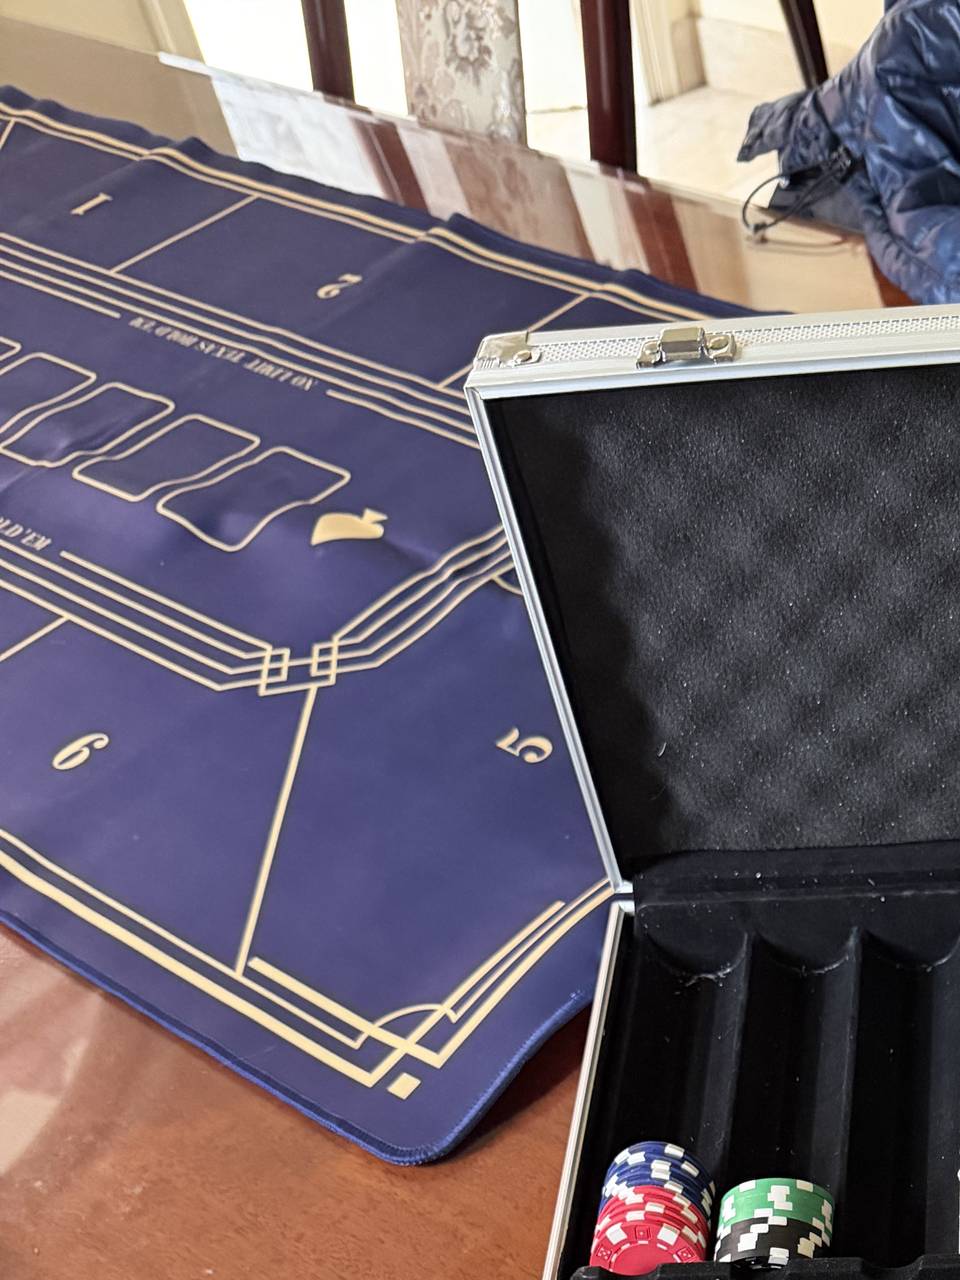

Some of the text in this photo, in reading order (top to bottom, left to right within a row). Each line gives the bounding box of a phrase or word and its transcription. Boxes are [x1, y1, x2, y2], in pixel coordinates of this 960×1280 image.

[317, 273, 363, 300] 2
[195, 340, 246, 363] TEXAS
[243, 358, 293, 383] LIMIT
[290, 374, 319, 392] NO
[53, 733, 109, 770] 6
[496, 727, 553, 764] 5
